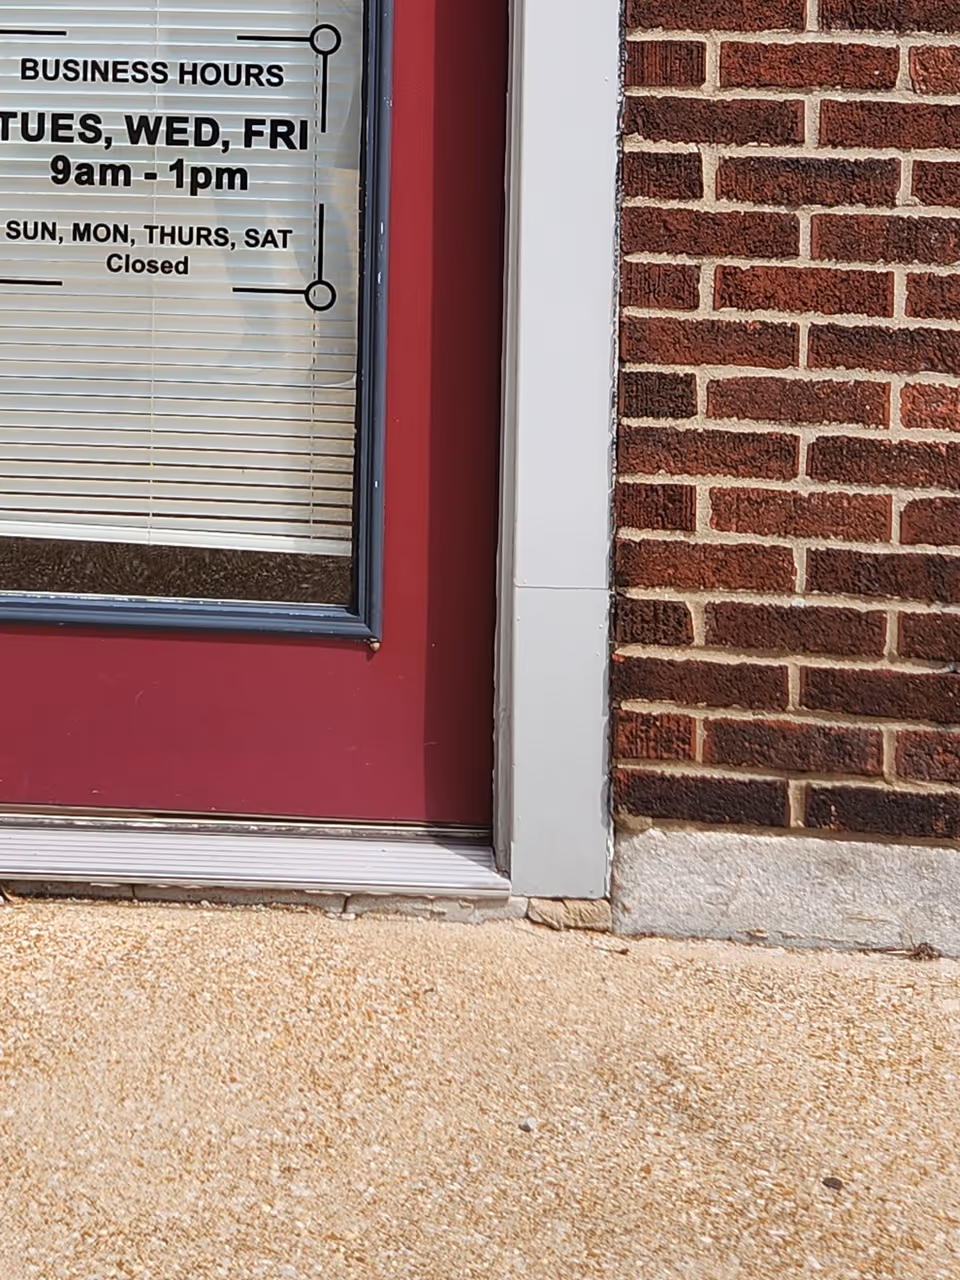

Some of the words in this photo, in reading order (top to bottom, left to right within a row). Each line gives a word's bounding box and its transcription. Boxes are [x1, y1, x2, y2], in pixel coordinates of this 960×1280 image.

[20, 58, 169, 84] BUSINESS
[179, 62, 285, 87] HOURS
[125, 115, 231, 153] WED,
[243, 119, 309, 150] FRI
[49, 155, 132, 187] 9am
[168, 159, 249, 196] 1pm
[5, 221, 64, 244] SUN,
[71, 223, 136, 247] MON,
[143, 224, 236, 250] THURS,
[243, 228, 293, 249] SAT
[106, 253, 189, 275] Closed
